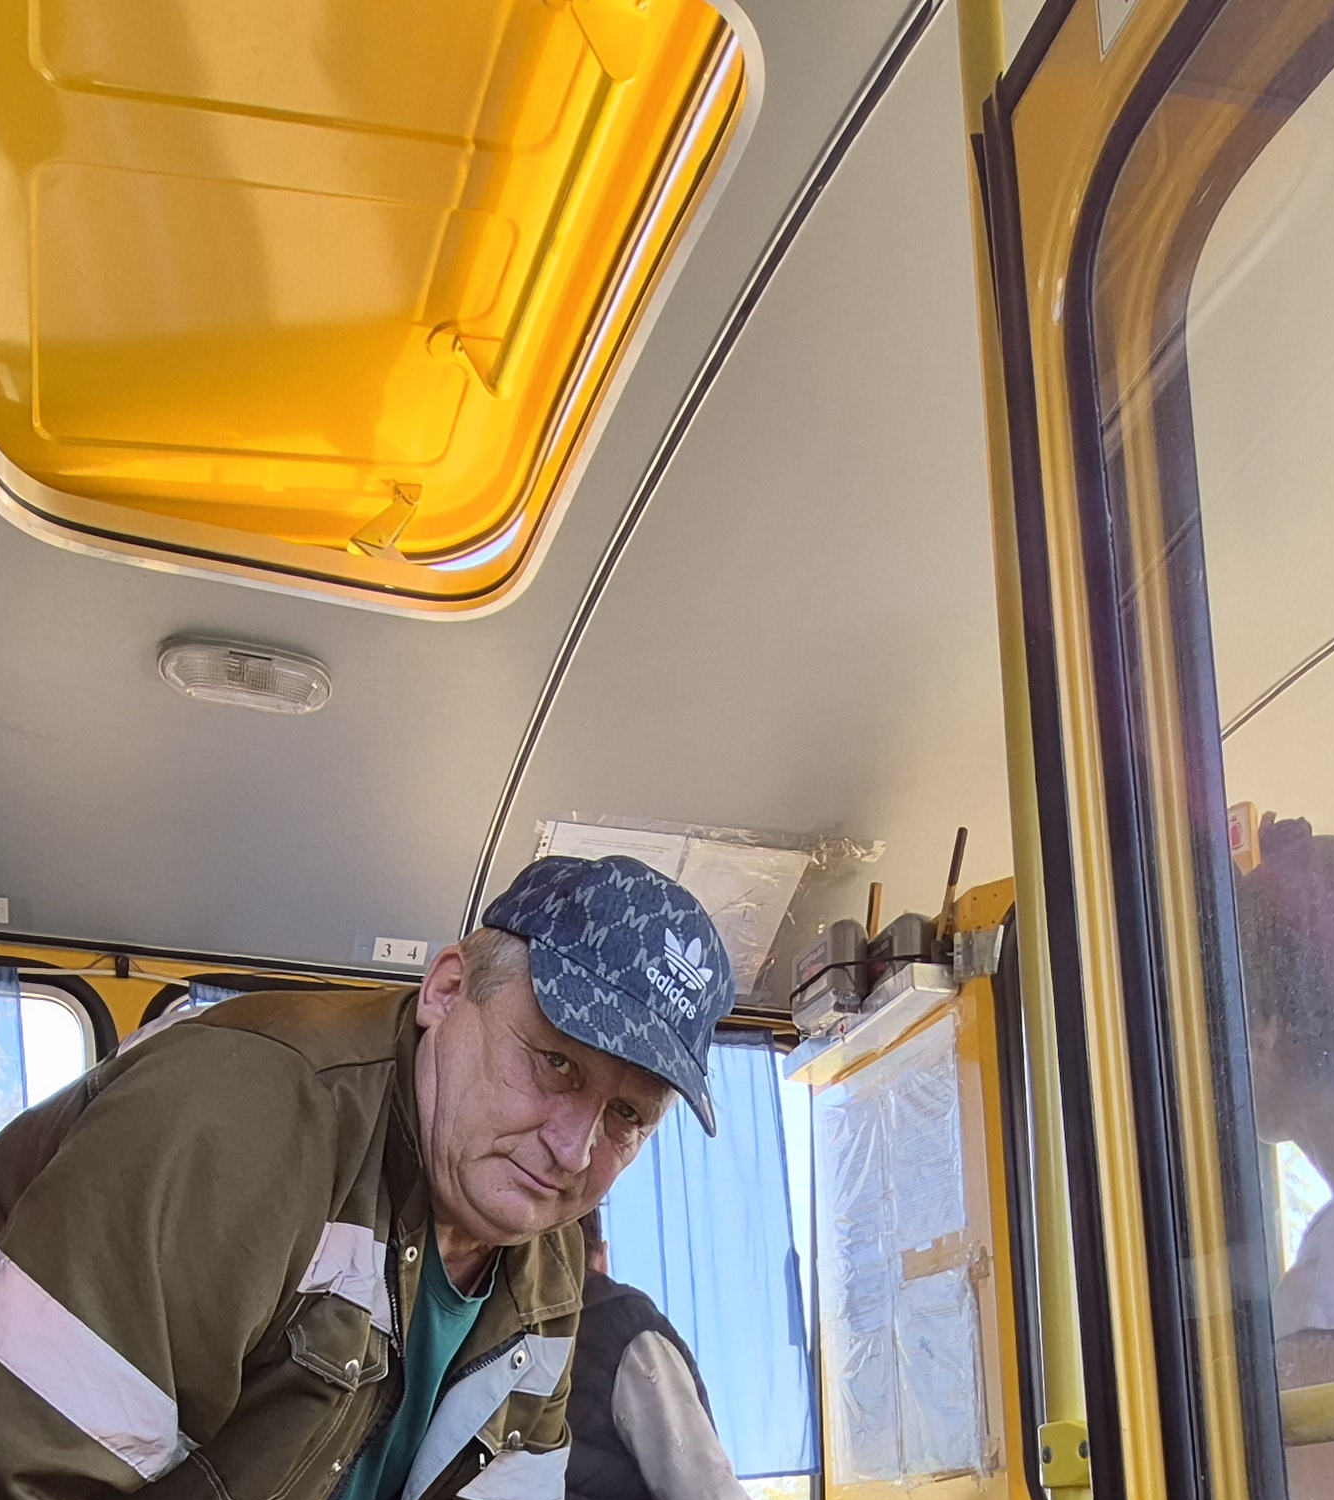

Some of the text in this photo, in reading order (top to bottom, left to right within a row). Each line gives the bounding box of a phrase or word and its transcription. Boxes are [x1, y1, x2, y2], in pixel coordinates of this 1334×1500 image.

[381, 943, 417, 959] 3 4
[646, 967, 696, 1019] adidas
